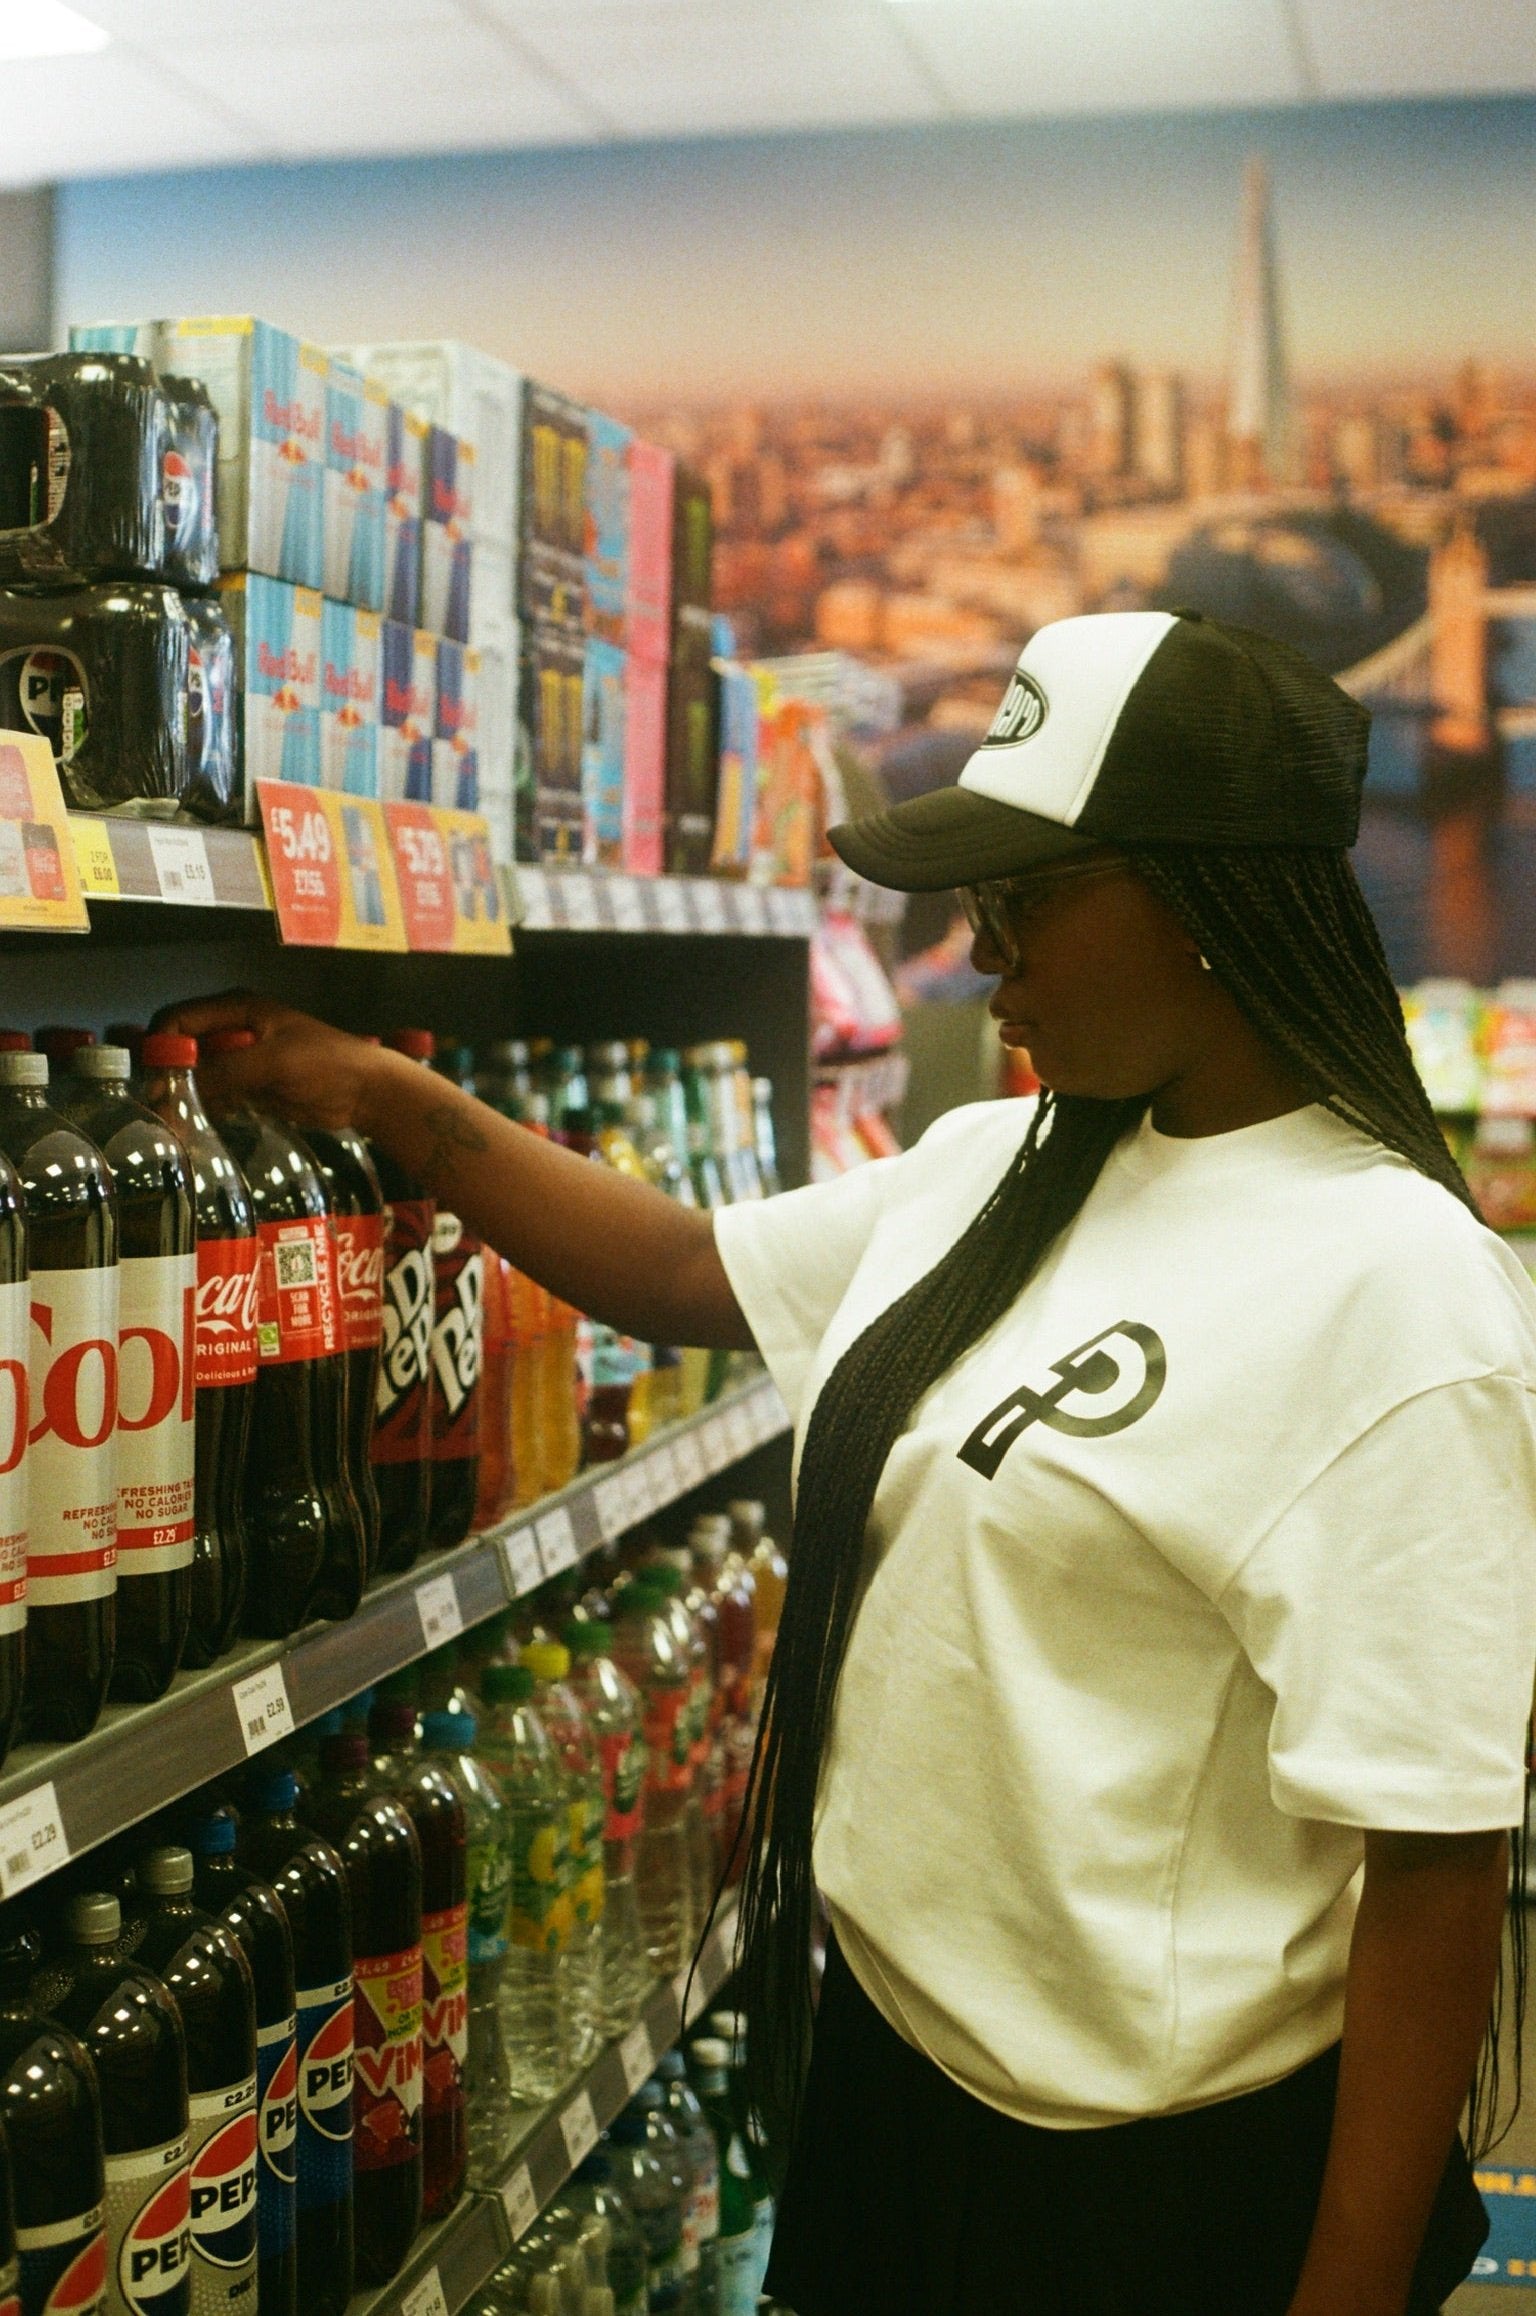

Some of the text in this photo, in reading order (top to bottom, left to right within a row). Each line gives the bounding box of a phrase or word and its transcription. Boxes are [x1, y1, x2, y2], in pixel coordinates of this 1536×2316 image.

[270, 806, 332, 864] £5.49
[313, 1223, 336, 1351] RECYCLE ME
[195, 1340, 251, 1357] RIGINAL
[196, 1369, 240, 1381] Delicious
[124, 1498, 144, 1509] NO
[136, 1503, 188, 1520] NO SUGAR
[83, 1516, 99, 1530] NO
[92, 1529, 105, 1541] NO
[153, 1529, 177, 1546] £2.29
[266, 1697, 286, 1720] £2.59
[31, 1823, 57, 1851] £2.29
